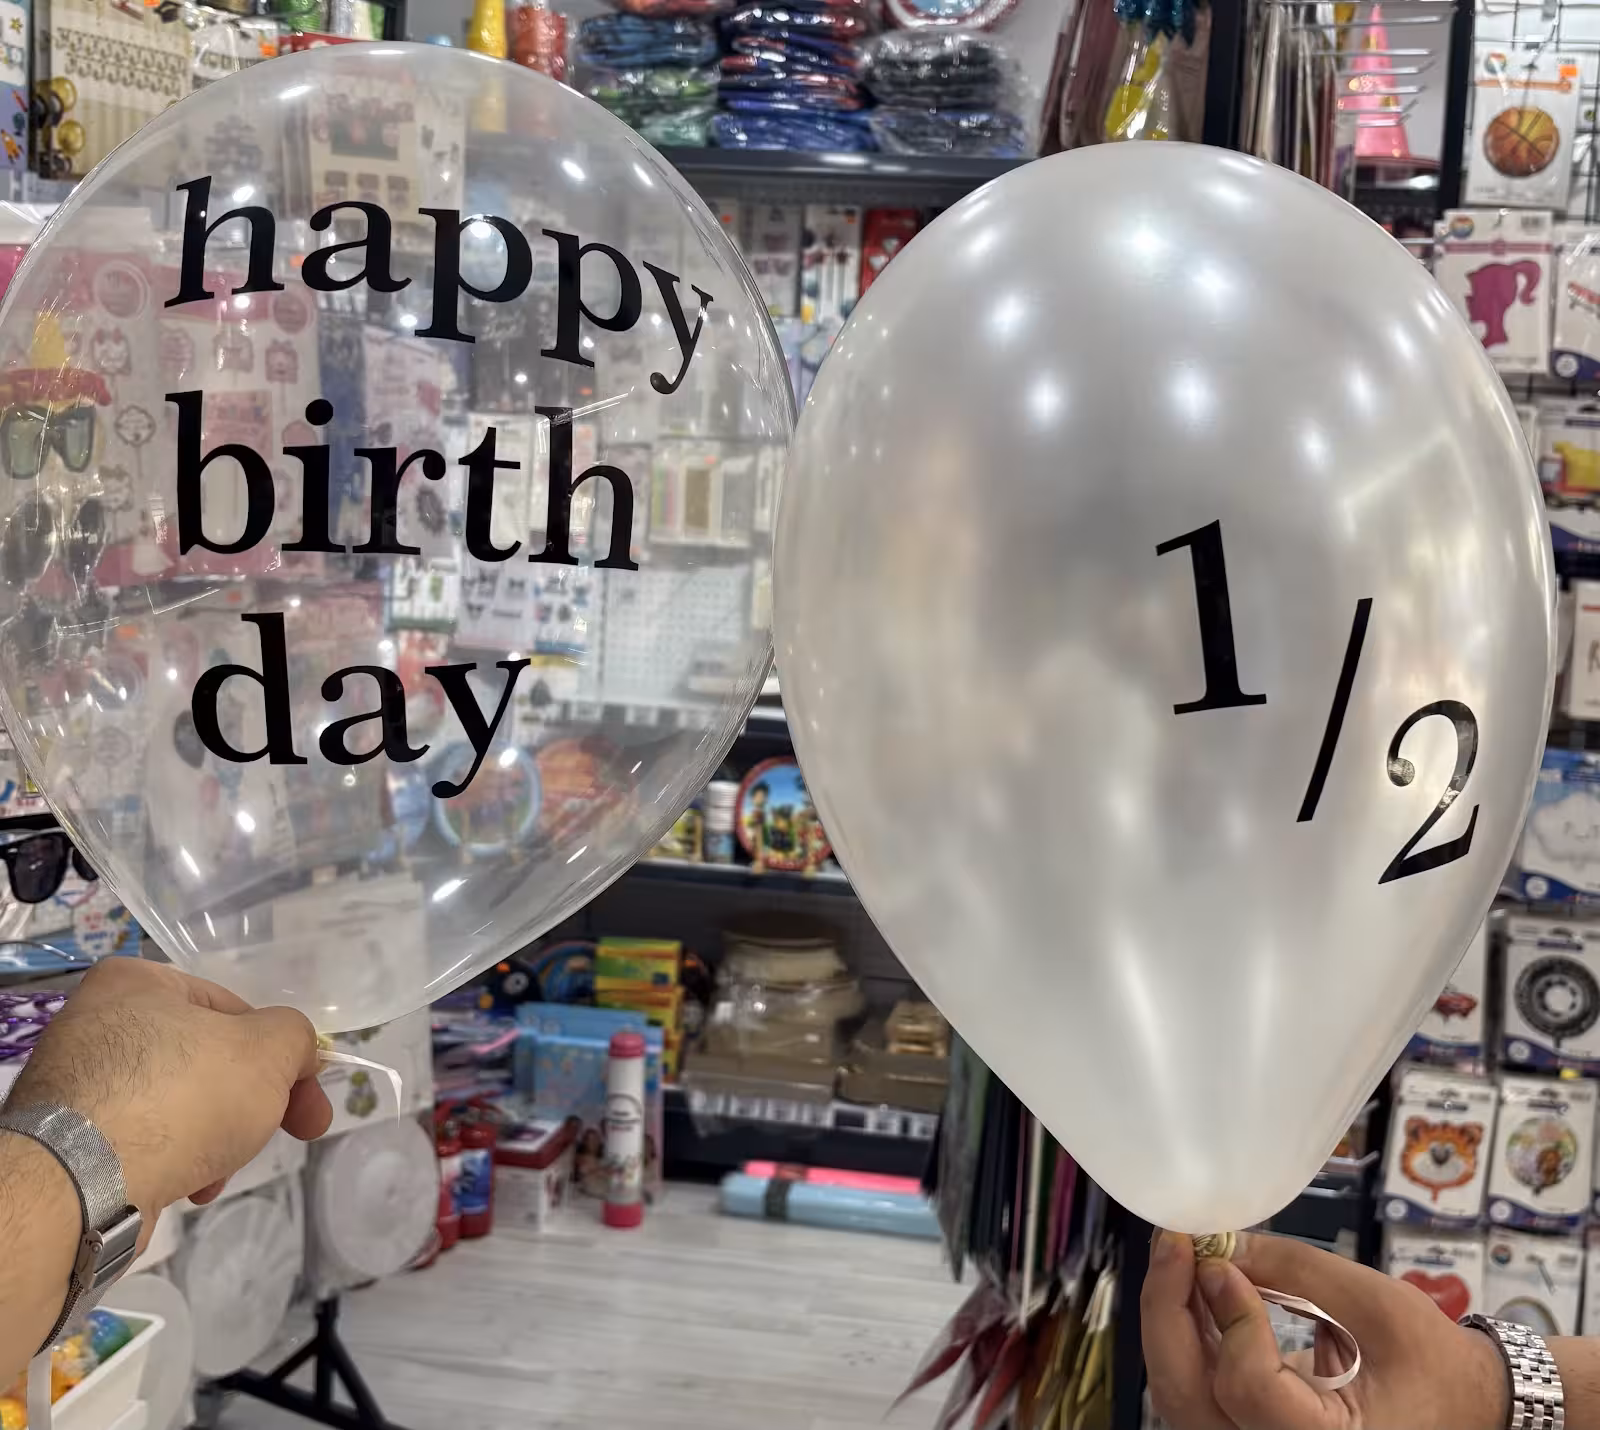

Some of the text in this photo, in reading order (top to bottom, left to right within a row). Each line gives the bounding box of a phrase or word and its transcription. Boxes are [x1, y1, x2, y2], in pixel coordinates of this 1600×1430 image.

[164, 175, 715, 395] happy
[164, 389, 639, 573] birth
[190, 611, 532, 799] day
[1155, 518, 1480, 885] 1/2
